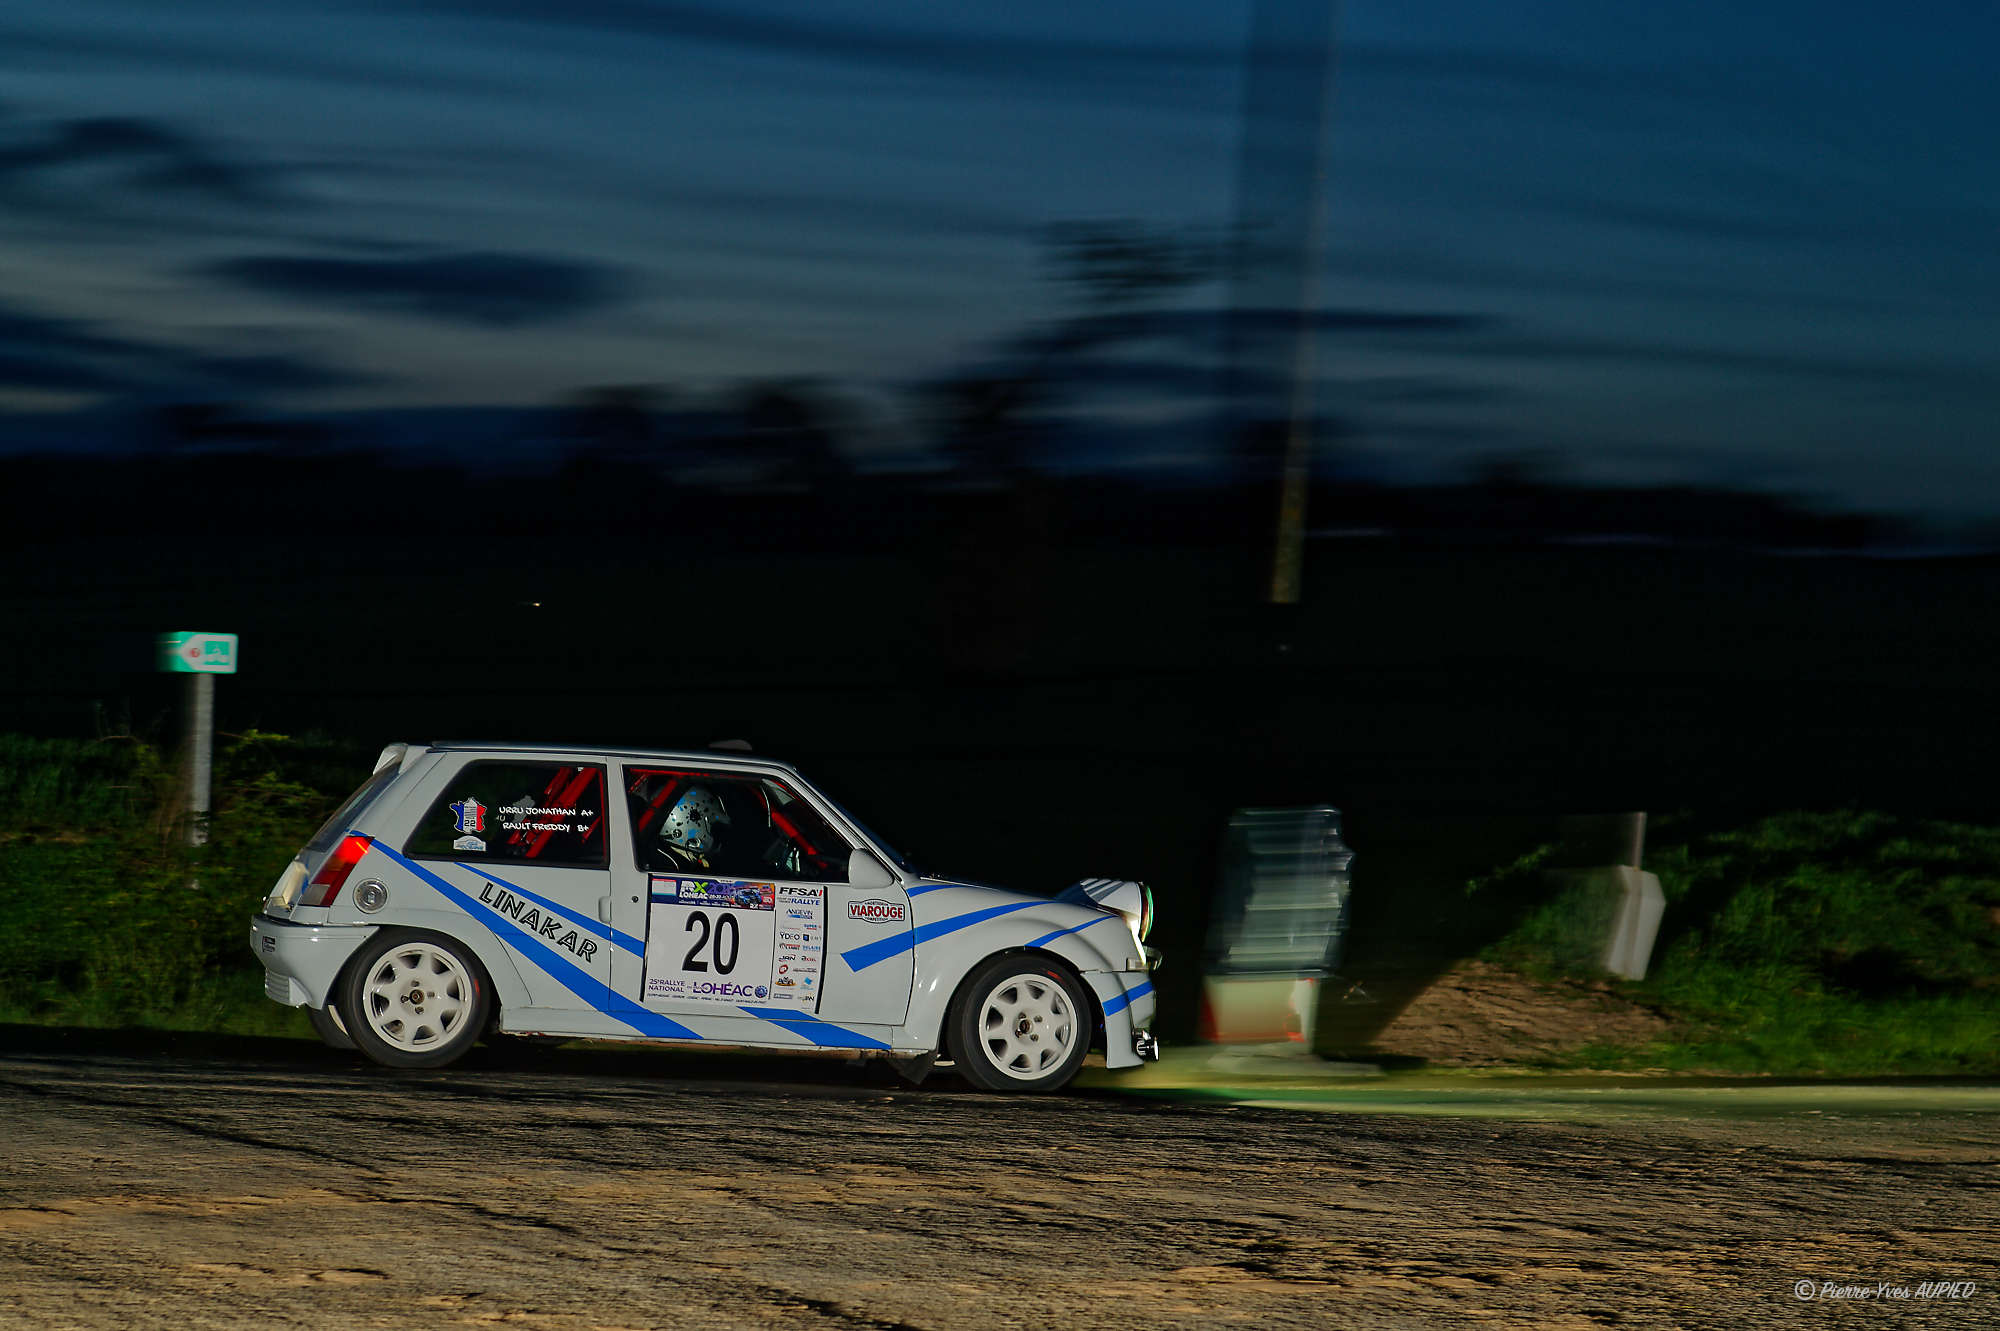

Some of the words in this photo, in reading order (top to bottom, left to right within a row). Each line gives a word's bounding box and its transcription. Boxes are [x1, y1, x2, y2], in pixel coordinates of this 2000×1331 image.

[499, 806, 524, 814] URRU
[525, 807, 576, 816] JONATHAN
[581, 809, 594, 817] A+
[503, 822, 531, 831] RAULT
[532, 823, 570, 833] FREDDY
[577, 824, 589, 832] B+
[779, 887, 818, 897] FFSA
[791, 898, 820, 906] RALLYE
[850, 904, 903, 919] VIAROUGE
[478, 881, 598, 963] LINAKAR
[682, 910, 739, 975] 20
[659, 979, 685, 987] RALLYE
[648, 985, 684, 993] NATIONAL
[693, 981, 753, 997] LOHÉAC
